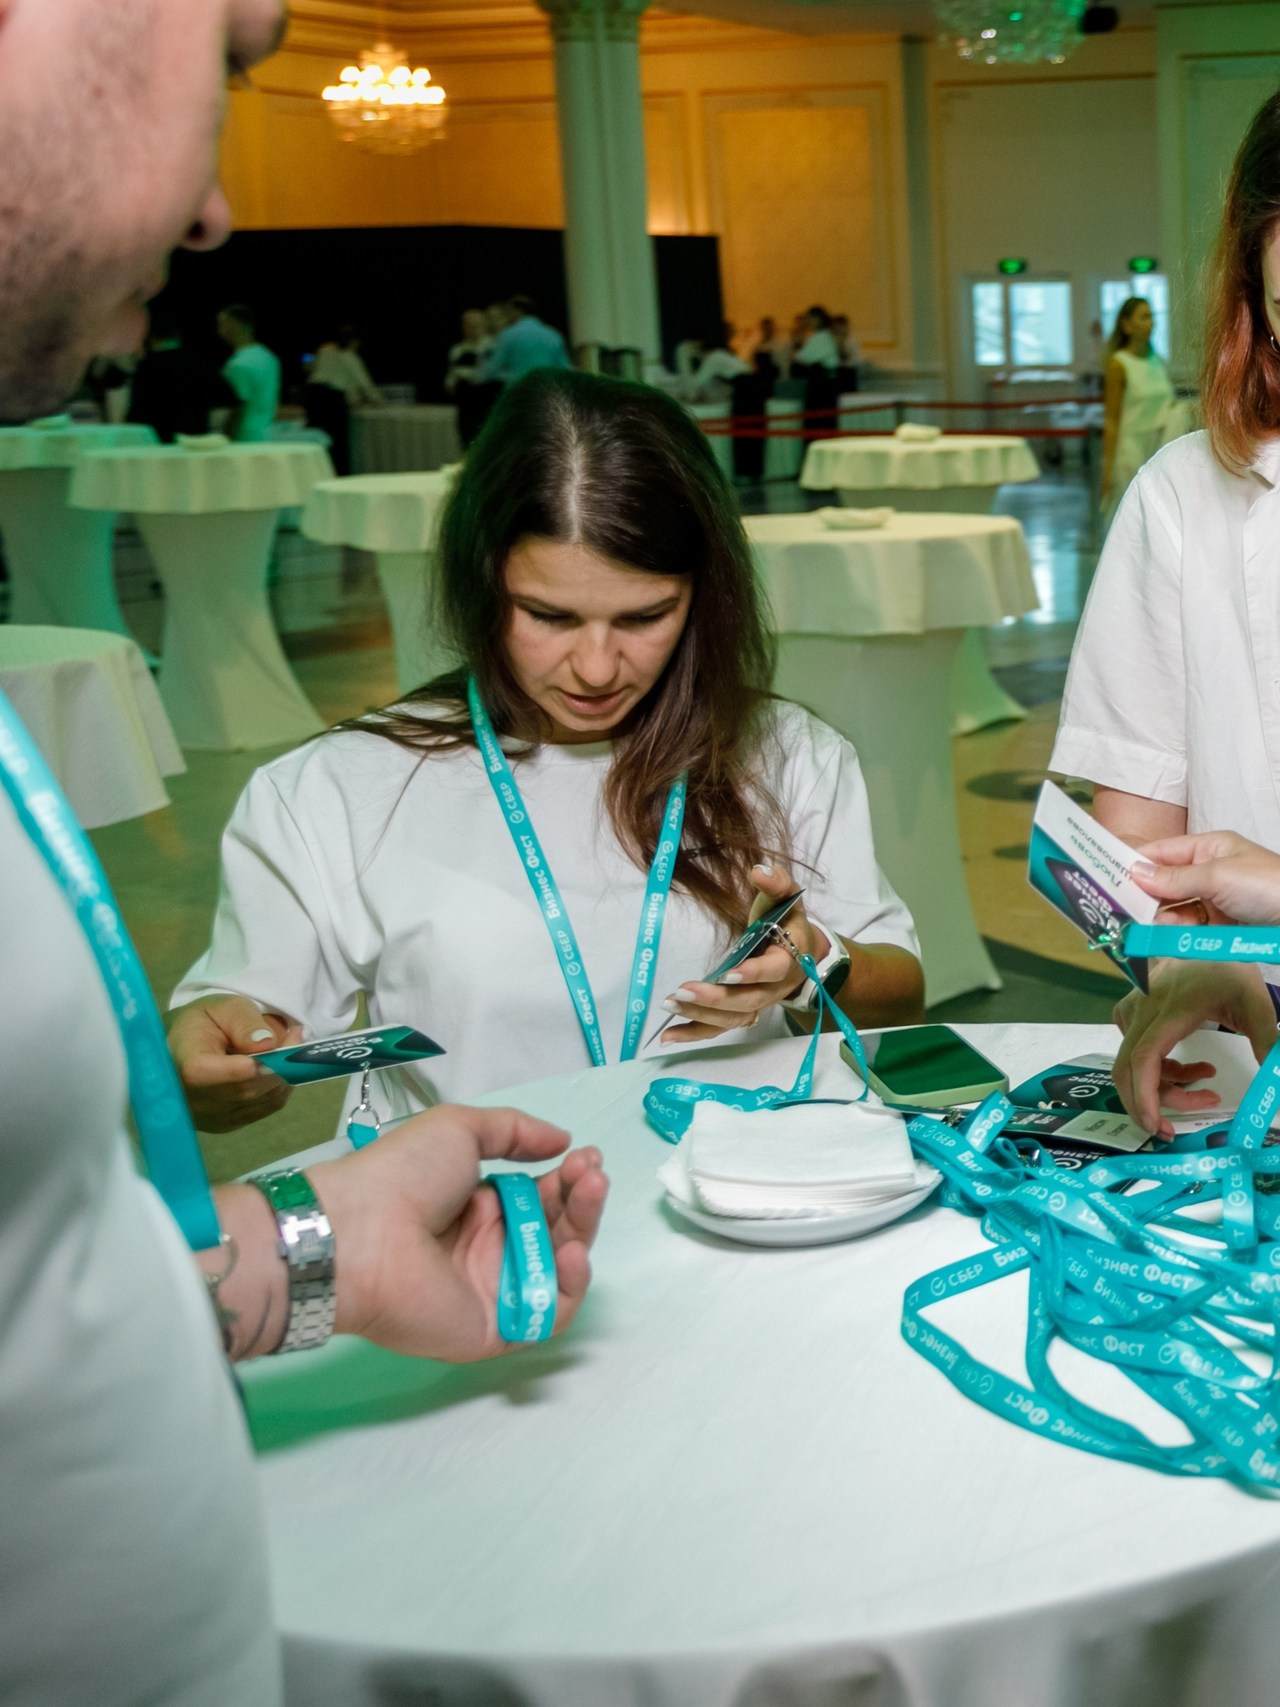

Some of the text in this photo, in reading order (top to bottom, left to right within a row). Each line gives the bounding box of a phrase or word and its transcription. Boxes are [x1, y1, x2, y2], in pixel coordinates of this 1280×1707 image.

[500, 782, 518, 810] СБЕР
[668, 796, 684, 832] Фест
[519, 834, 561, 919] Бизнес Фест
[1070, 835, 1123, 888] Любовь
[637, 855, 669, 986] СБЕР Бизнес Фест
[557, 929, 575, 960] СБЕР
[1193, 937, 1223, 952] СБЕР
[1229, 936, 1277, 955] Бизнес
[576, 987, 605, 1067] знес Фест
[627, 1015, 640, 1047] СБЕР
[1068, 1075, 1115, 1087] изнес
[1257, 1085, 1277, 1116] СБЕР
[969, 1108, 1005, 1148] Фест
[932, 1131, 957, 1148] СБЕР
[956, 1150, 985, 1173] Биз
[1124, 1160, 1195, 1176] Бизнес
[1197, 1154, 1243, 1173] Фест
[1053, 1173, 1085, 1189] СБЕР
[519, 1221, 546, 1284] Бизнес
[949, 1246, 1028, 1287] СБЕР Биз
[1143, 1264, 1195, 1290] Фест
[1103, 1335, 1145, 1357] Фест
[1003, 1391, 1050, 1426] Фест
